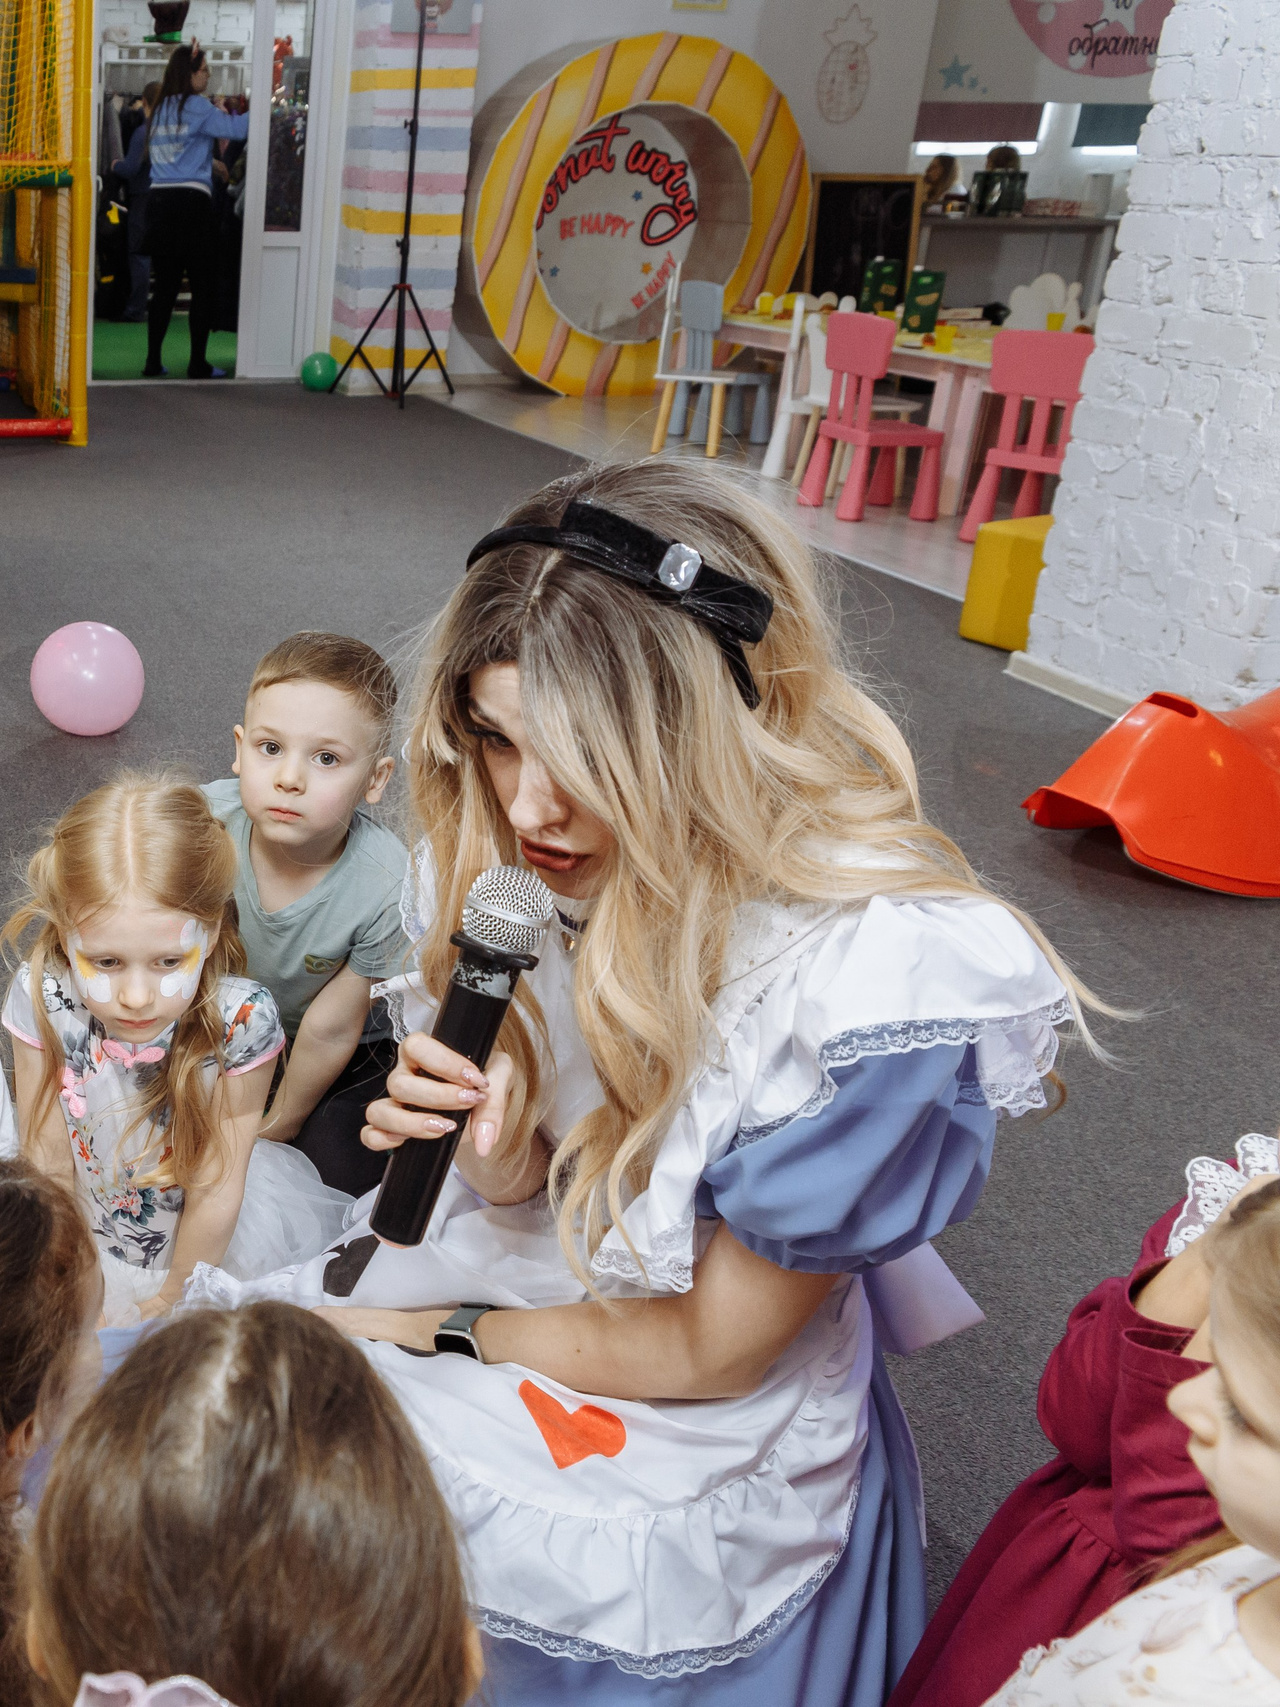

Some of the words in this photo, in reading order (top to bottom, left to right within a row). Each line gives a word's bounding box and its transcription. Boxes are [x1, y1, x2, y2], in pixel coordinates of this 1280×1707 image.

[1068, 18, 1159, 70] обратн
[536, 115, 630, 231] onut
[625, 140, 698, 246] worry
[559, 216, 578, 240] BE
[579, 212, 635, 238] HAPPY
[630, 291, 647, 310] BE
[644, 250, 677, 298] HAPPY
